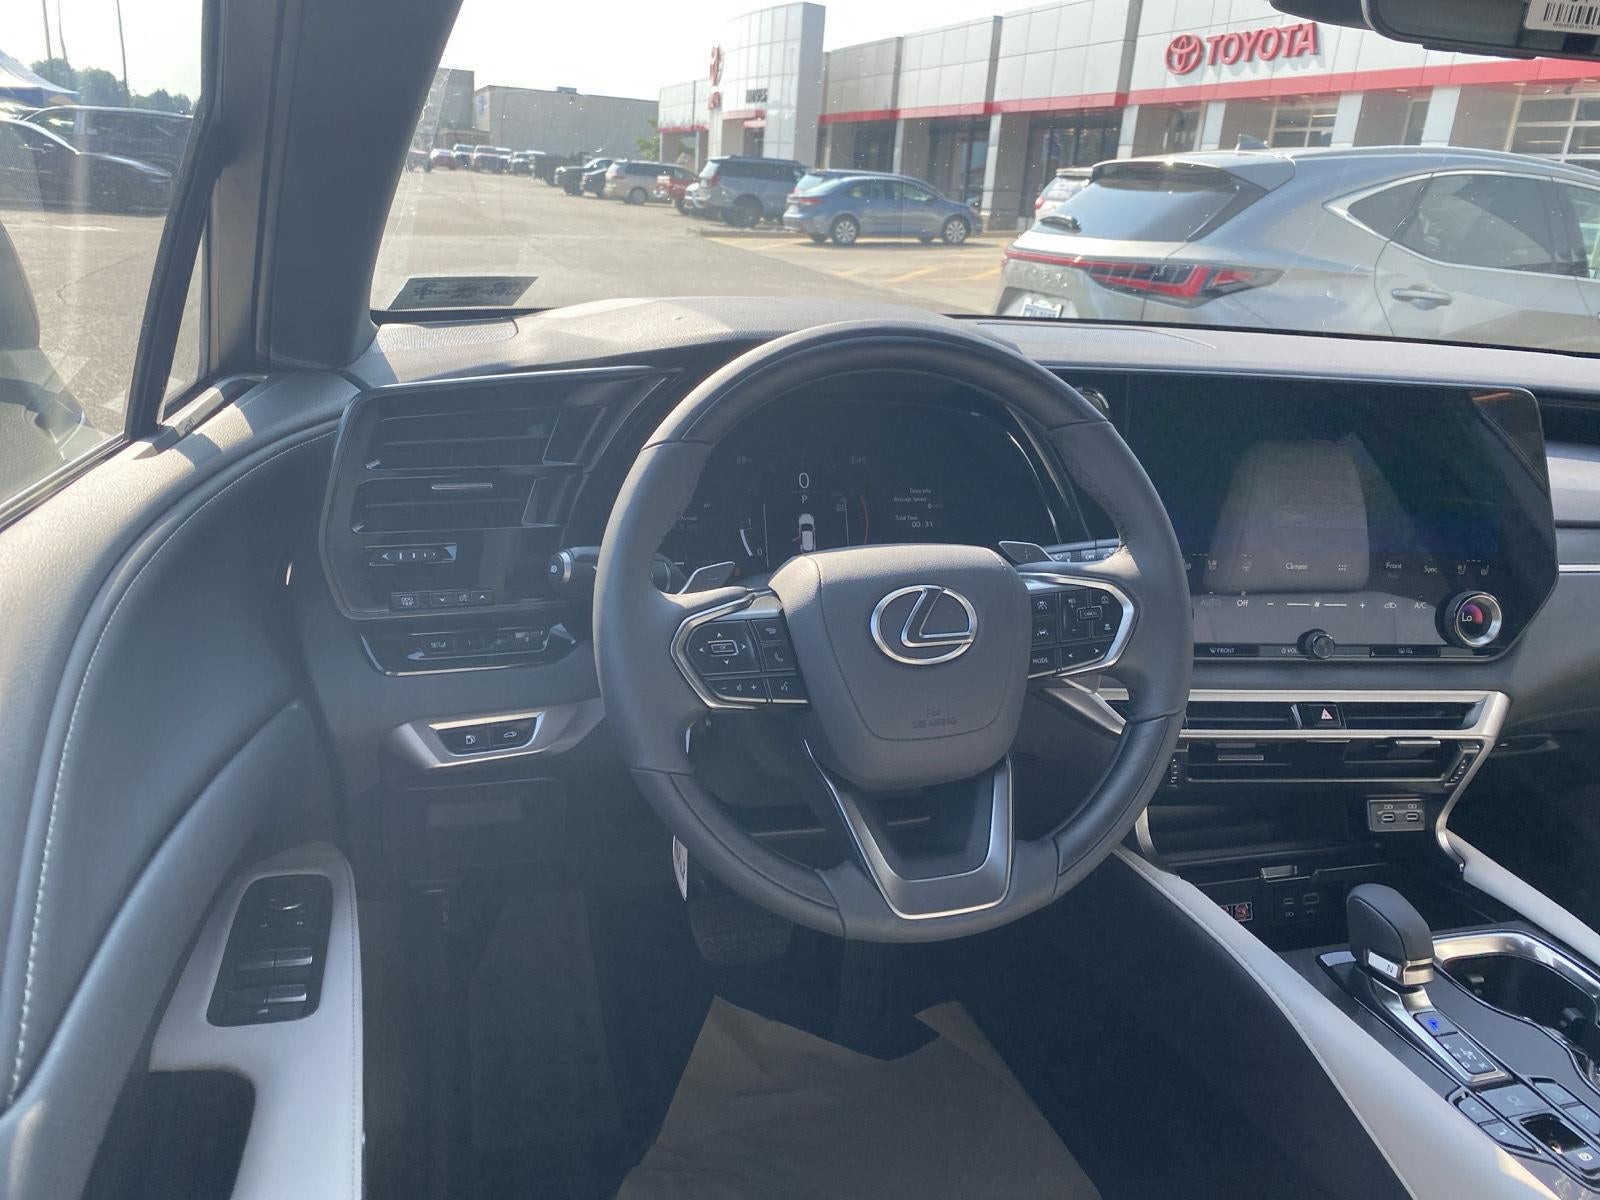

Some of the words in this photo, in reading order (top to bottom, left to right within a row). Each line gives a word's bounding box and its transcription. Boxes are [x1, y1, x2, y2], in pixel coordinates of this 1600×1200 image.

[1206, 21, 1317, 66] TOYOTA
[799, 472, 809, 489] 0
[801, 495, 808, 504] P
[911, 520, 933, 529] 00:31
[1285, 562, 1308, 570] Climate
[1385, 561, 1402, 570] Front
[1424, 565, 1438, 574] Sync
[1200, 598, 1222, 607] AUTO
[1236, 599, 1249, 607] Off
[1414, 601, 1427, 610] A/C
[1461, 612, 1473, 622] Lo
